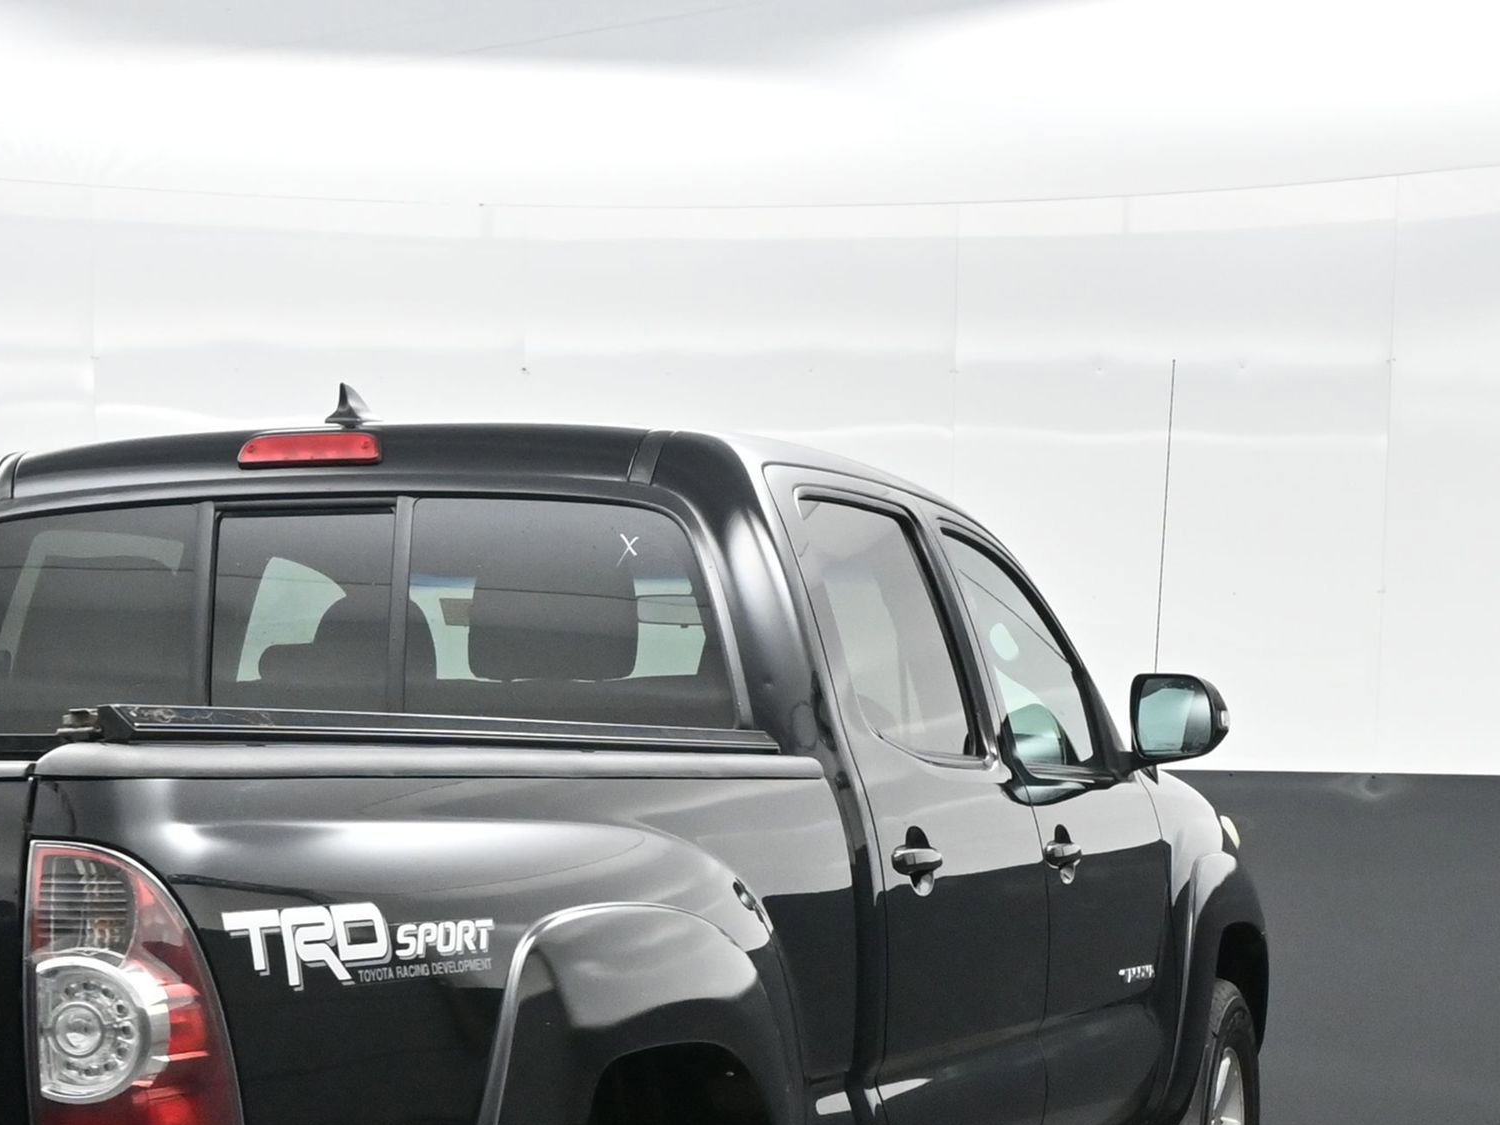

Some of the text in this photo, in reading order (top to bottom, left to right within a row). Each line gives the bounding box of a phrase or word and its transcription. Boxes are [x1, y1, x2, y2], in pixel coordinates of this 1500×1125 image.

[221, 902, 494, 992] TRD SPORT
[358, 958, 492, 982] TOYOTA RACING DEVELOPMENT
